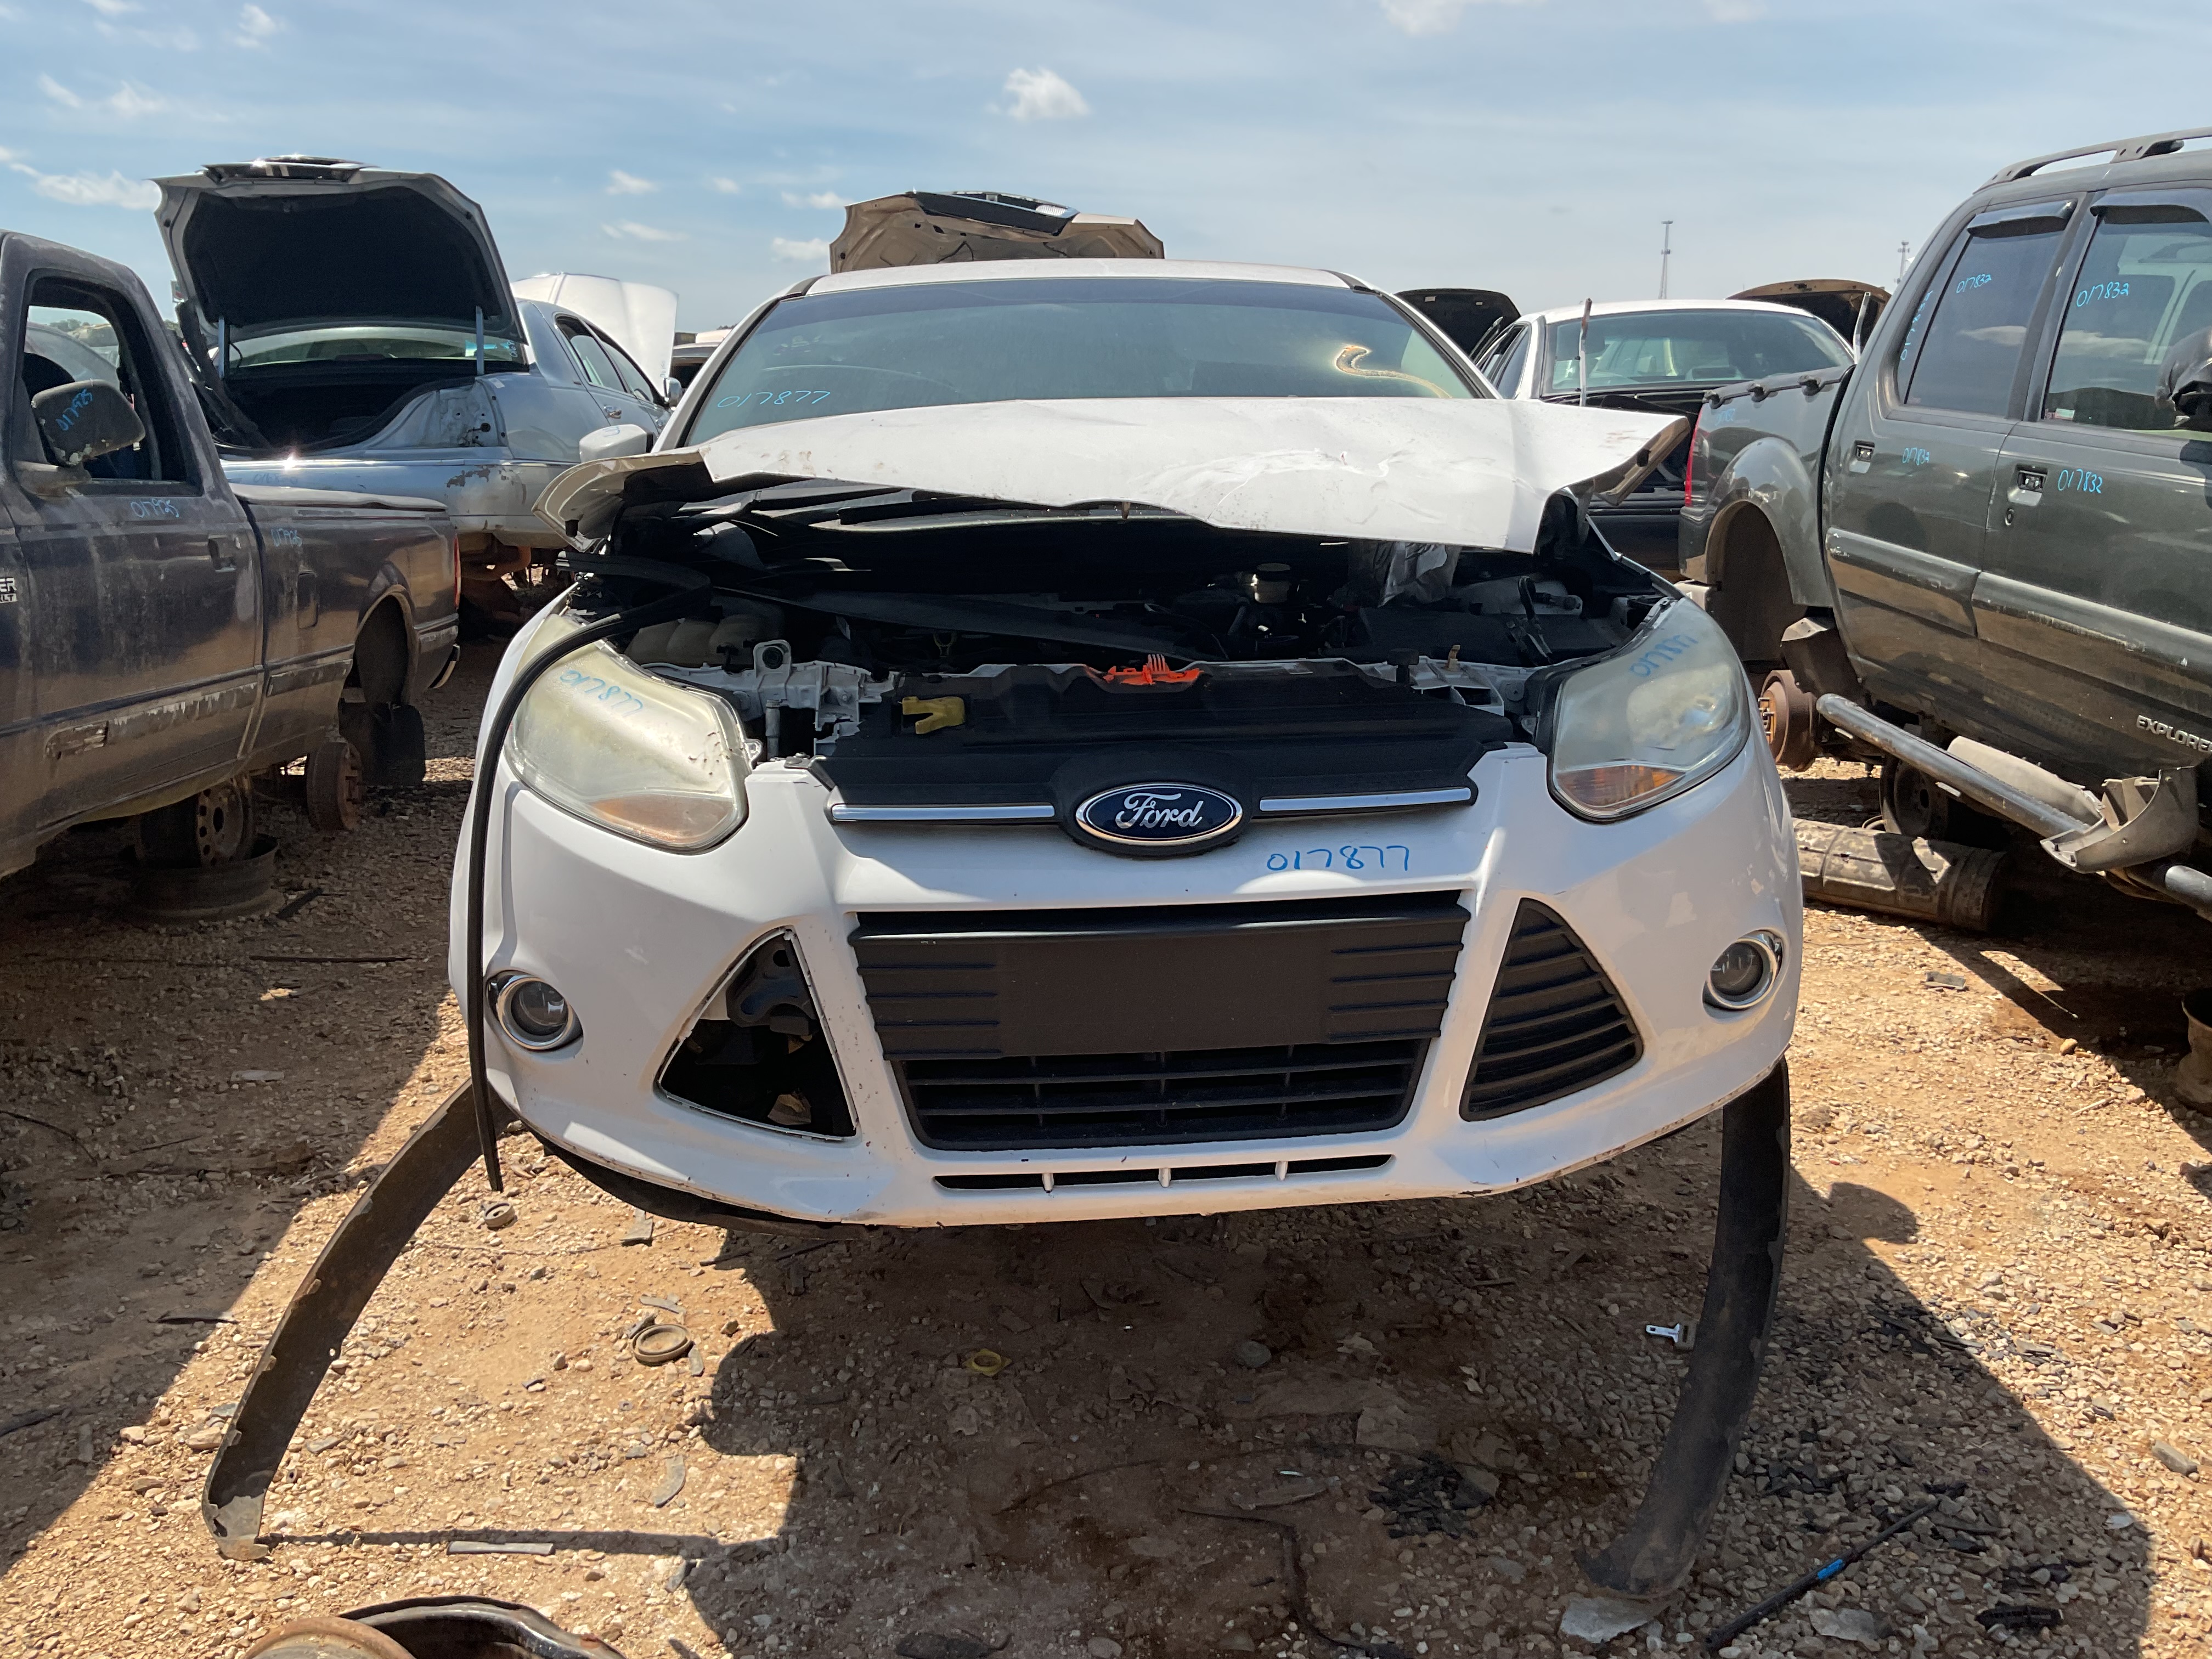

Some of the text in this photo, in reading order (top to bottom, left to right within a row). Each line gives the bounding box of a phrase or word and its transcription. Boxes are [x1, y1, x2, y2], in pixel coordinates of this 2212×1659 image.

[1956, 274, 1991, 294] 017832
[2076, 281, 2129, 307] 017832
[718, 391, 831, 408] 017877
[1902, 447, 1929, 466] 017832
[2057, 469, 2102, 493] 017832
[560, 670, 643, 718] 017877
[2136, 715, 2212, 754] EXPLORE
[1115, 793, 1204, 829] Ford
[1267, 845, 1409, 871] 017877
